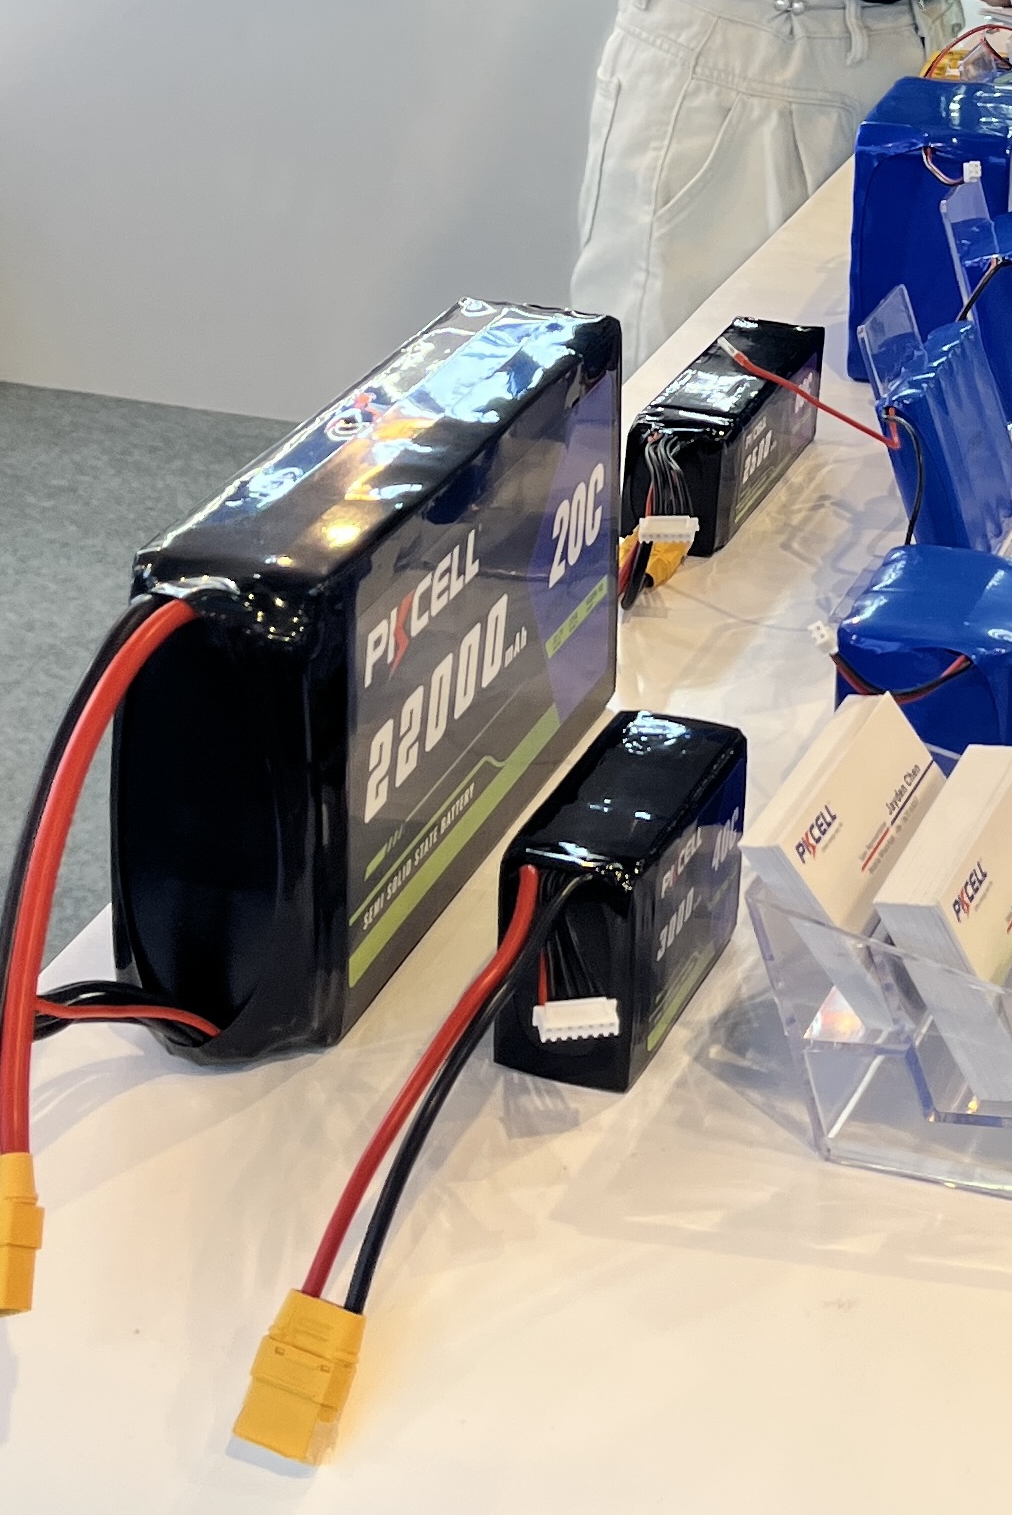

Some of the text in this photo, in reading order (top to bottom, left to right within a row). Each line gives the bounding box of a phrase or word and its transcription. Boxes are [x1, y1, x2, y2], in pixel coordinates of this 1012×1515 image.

[549, 463, 605, 588] 20C
[364, 529, 480, 688] PKCELL
[363, 782, 475, 930] SEMI SOLID STATE BATTERY
[661, 826, 702, 900] PKCELL
[795, 804, 837, 865] PKCELL
[952, 860, 988, 924] PKCELL
